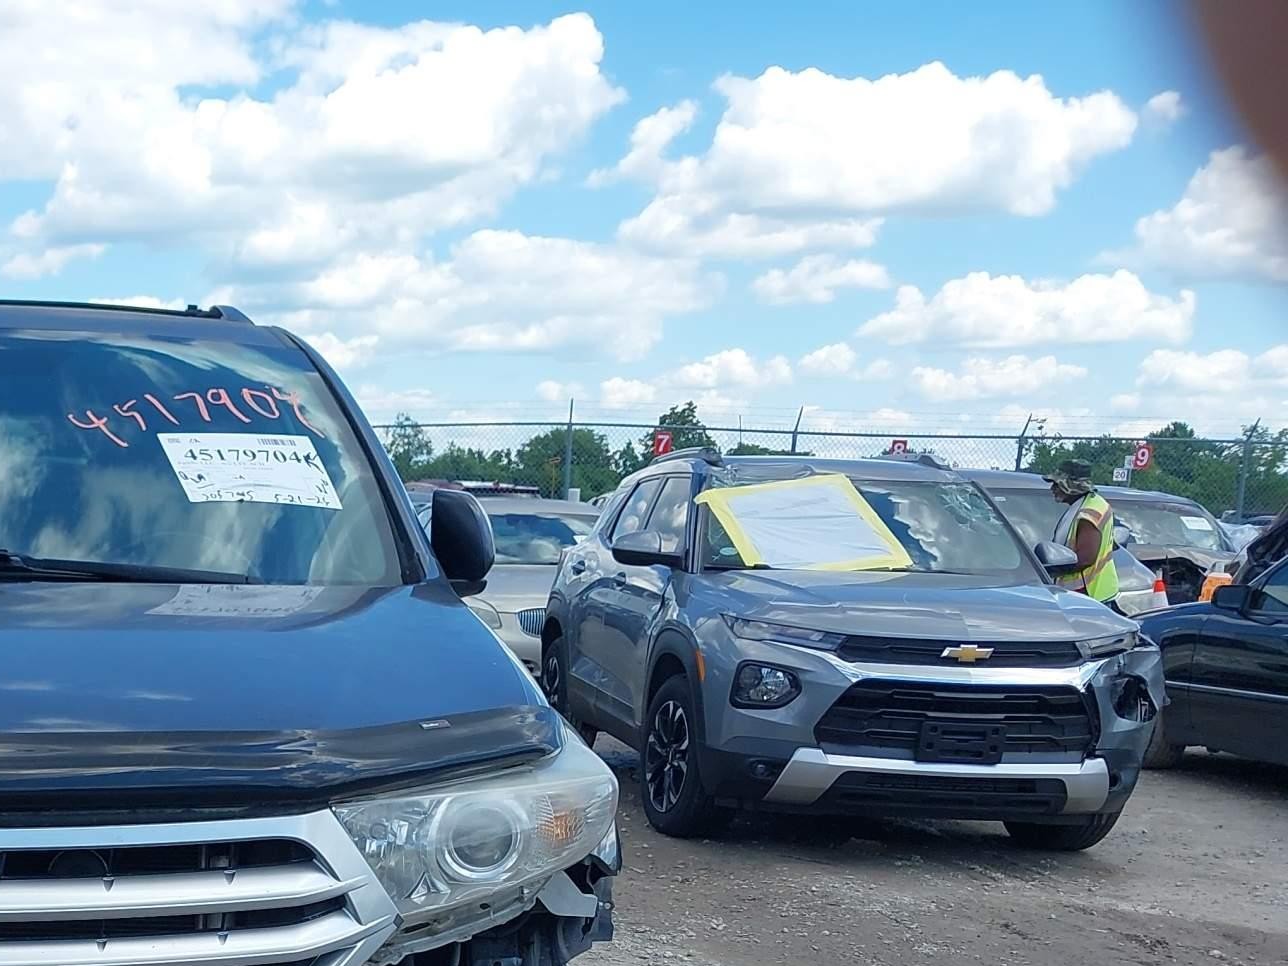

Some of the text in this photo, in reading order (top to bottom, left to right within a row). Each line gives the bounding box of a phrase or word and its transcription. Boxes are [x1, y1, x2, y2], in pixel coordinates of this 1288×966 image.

[657, 434, 670, 452] 7
[893, 442, 906, 455] 8
[183, 448, 302, 464] 45179704
[1136, 448, 1149, 466] 9
[1114, 471, 1126, 479] 20
